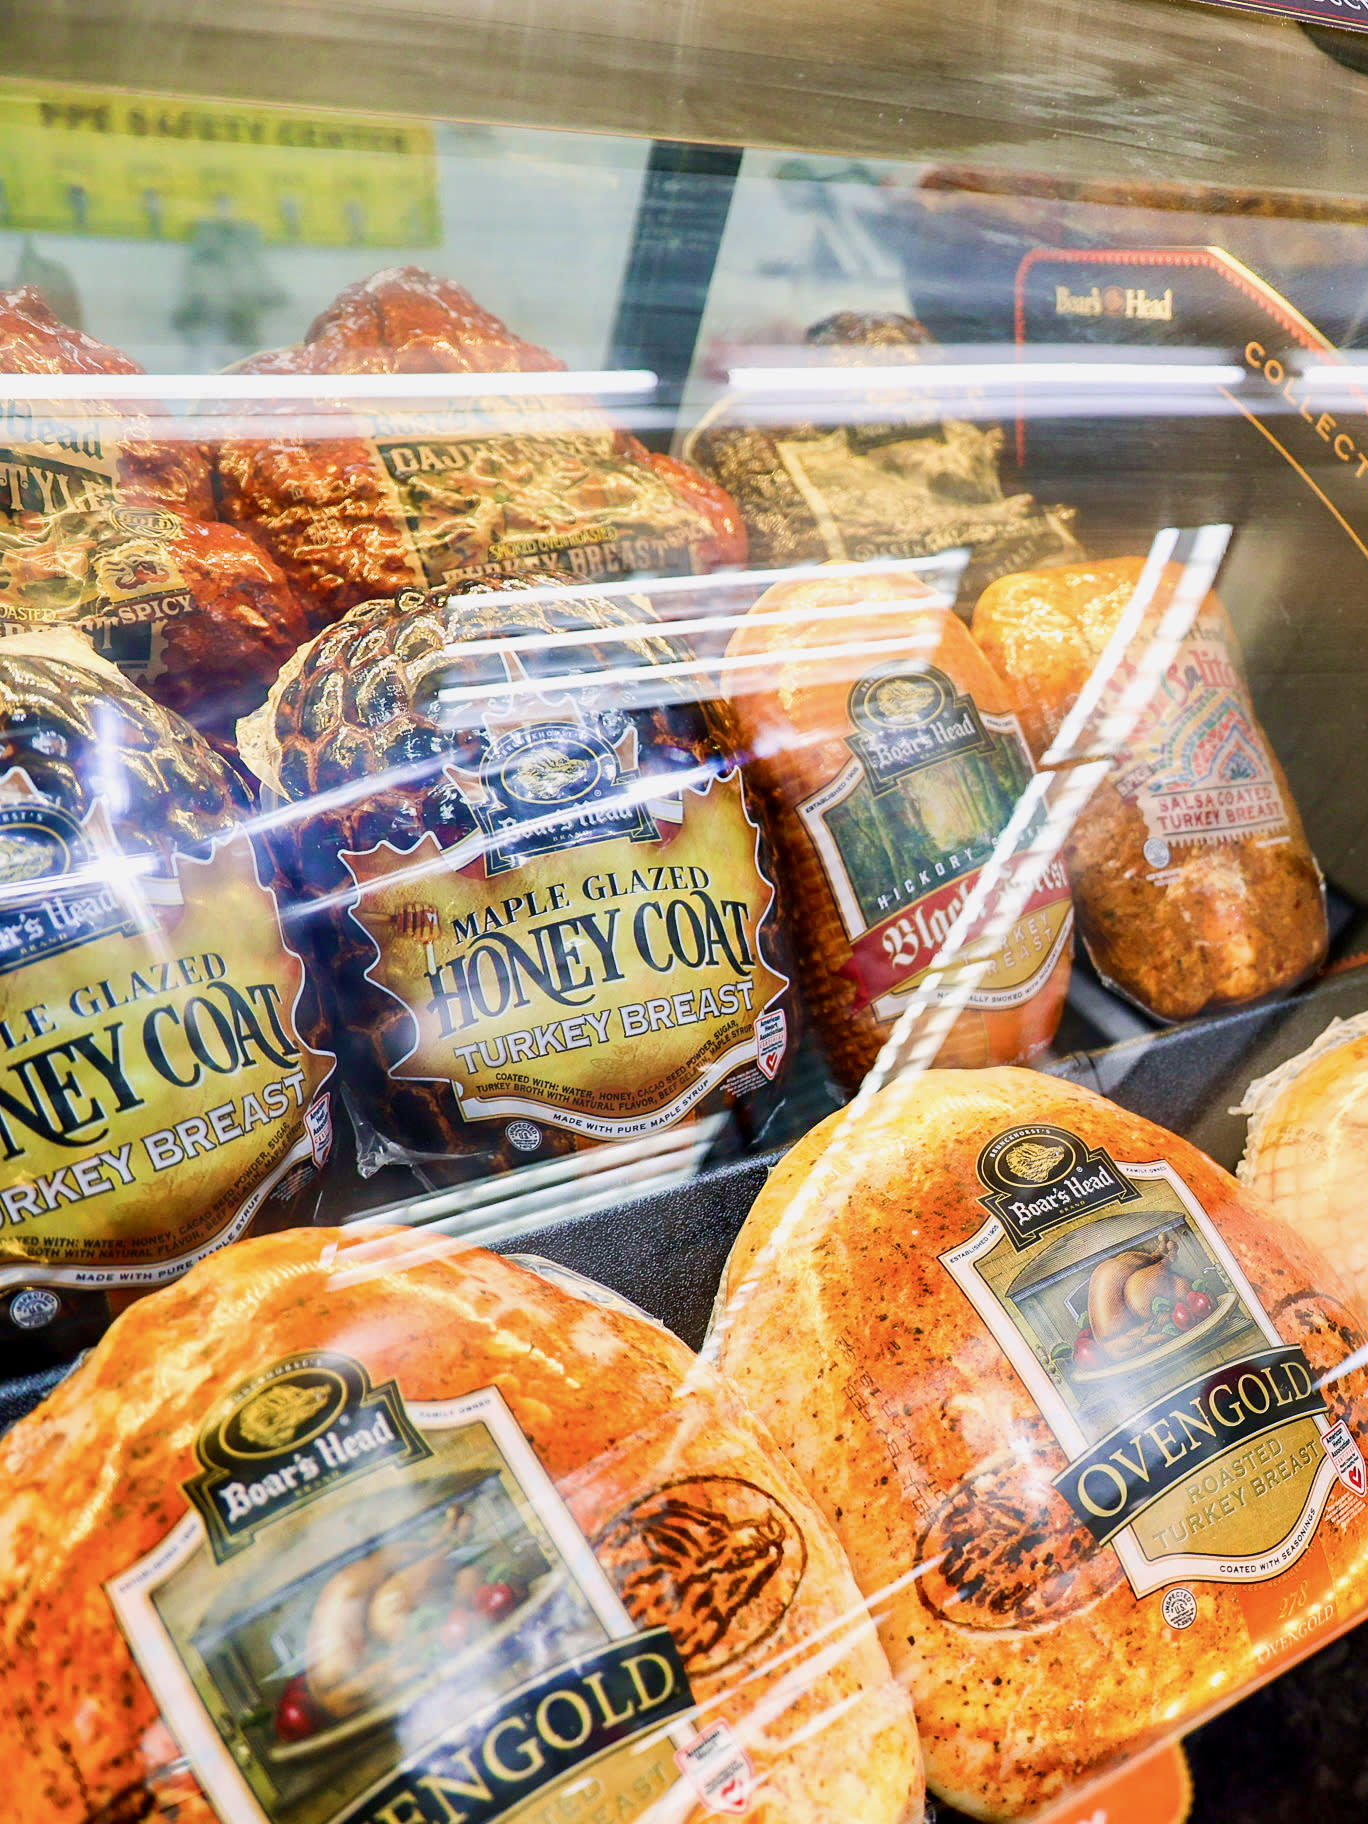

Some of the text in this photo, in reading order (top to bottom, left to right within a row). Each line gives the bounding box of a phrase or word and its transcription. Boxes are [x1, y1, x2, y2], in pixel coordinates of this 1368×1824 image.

[567, 538, 667, 575] BREAST
[118, 594, 194, 626] SPICY
[873, 713, 976, 770] Boar's Head
[1157, 802, 1282, 831] TURKEY BREAST
[1159, 786, 1273, 814] SALSA COATED
[452, 864, 711, 945] MAPLE GLAZED
[877, 847, 974, 911] HICKORY
[69, 952, 229, 1020] GLAZED
[425, 889, 758, 1040] HONEY COAT
[142, 980, 305, 1089] COAT
[455, 979, 755, 1076] TURKEY BREAST
[495, 1018, 739, 1103] COATED WITH: WATER, HONEY, CACAO SEED POWDER, SUGAR,
[476, 1082, 511, 1094] TURKEY
[513, 1083, 545, 1096] BROTH
[546, 1090, 571, 1104] WITH
[571, 1096, 616, 1112] NATURAL
[618, 1096, 659, 1111] FLAVOR,
[658, 1082, 678, 1099] BEEF
[709, 1036, 731, 1055] MAPLE
[552, 1112, 583, 1128] MADE
[585, 1121, 614, 1135] WITH
[616, 1122, 647, 1135] PURE
[649, 1106, 682, 1128] MAPLE
[681, 1078, 710, 1108] SYRUP
[0, 1071, 306, 1233] RKEY BREAST
[989, 1127, 1051, 1158] BRUNCKHORST'S
[1007, 1165, 1116, 1227] Boar's Head
[75, 1271, 116, 1283] MADE
[118, 1271, 154, 1282] WITH
[157, 1260, 195, 1279] PURE
[234, 1193, 262, 1232] SYRUP
[949, 1236, 990, 1264] ESTABLISHED
[218, 1452, 321, 1525] Boar's
[313, 1410, 395, 1469] Head
[1077, 1358, 1316, 1521] OVENGOLD
[1184, 1436, 1285, 1505] ROASTED
[1152, 1439, 1323, 1551] TURKEY BREAST
[1219, 1507, 1317, 1574] COATED WITH SEASONINGS
[1165, 1591, 1192, 1614] INSPECTED
[1256, 1604, 1336, 1666] OVENGOLD
[363, 1652, 676, 1824] ENGOLD
